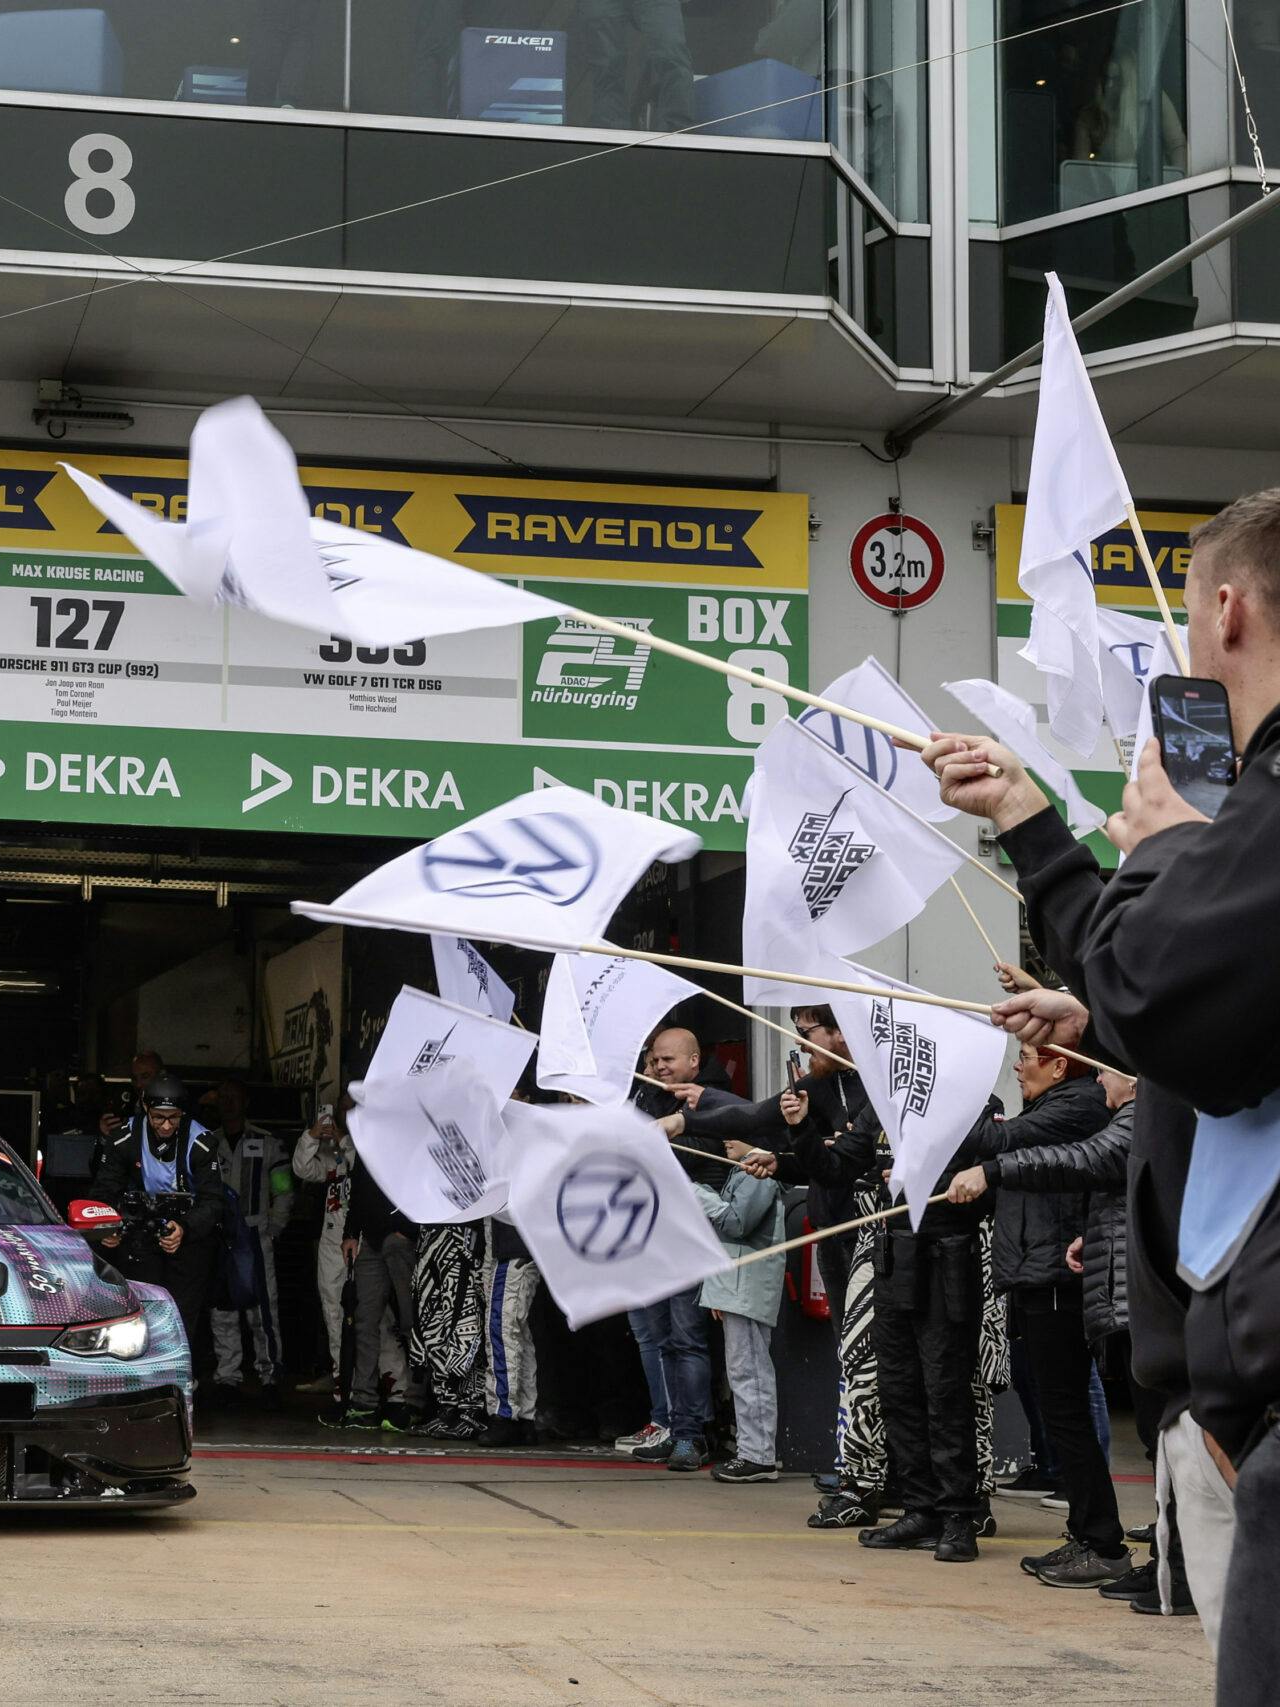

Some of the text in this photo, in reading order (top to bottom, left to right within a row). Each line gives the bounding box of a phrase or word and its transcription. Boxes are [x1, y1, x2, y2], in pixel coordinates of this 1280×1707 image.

[485, 35, 554, 45] FALKEN
[64, 133, 135, 235] 8
[487, 511, 733, 551] RAVENOL
[12, 563, 145, 583] MAX KRUSE RACING
[870, 541, 925, 579] 3,2m
[30, 596, 125, 651] 127
[688, 595, 793, 646] BOX
[50, 660, 68, 673] 911
[72, 662, 94, 674] GT3
[98, 663, 122, 675] CUP
[125, 663, 158, 678] (992)
[303, 673, 442, 691] VW GOLF 7 GTI TCR DSG
[560, 677, 586, 686] ADAC
[55, 689, 69, 697] Tom
[72, 699, 92, 709] Meijer
[349, 693, 376, 703] Matthias
[531, 687, 639, 710] nürburgring
[727, 649, 790, 743] 8
[69, 710, 98, 719] Monteiro
[25, 751, 181, 798] DEKRA
[312, 765, 465, 811] DEKRA
[593, 778, 745, 824] DEKRA
[791, 816, 827, 859] MAX
[908, 1038, 934, 1113] RACING
[29, 1273, 57, 1294] 50
